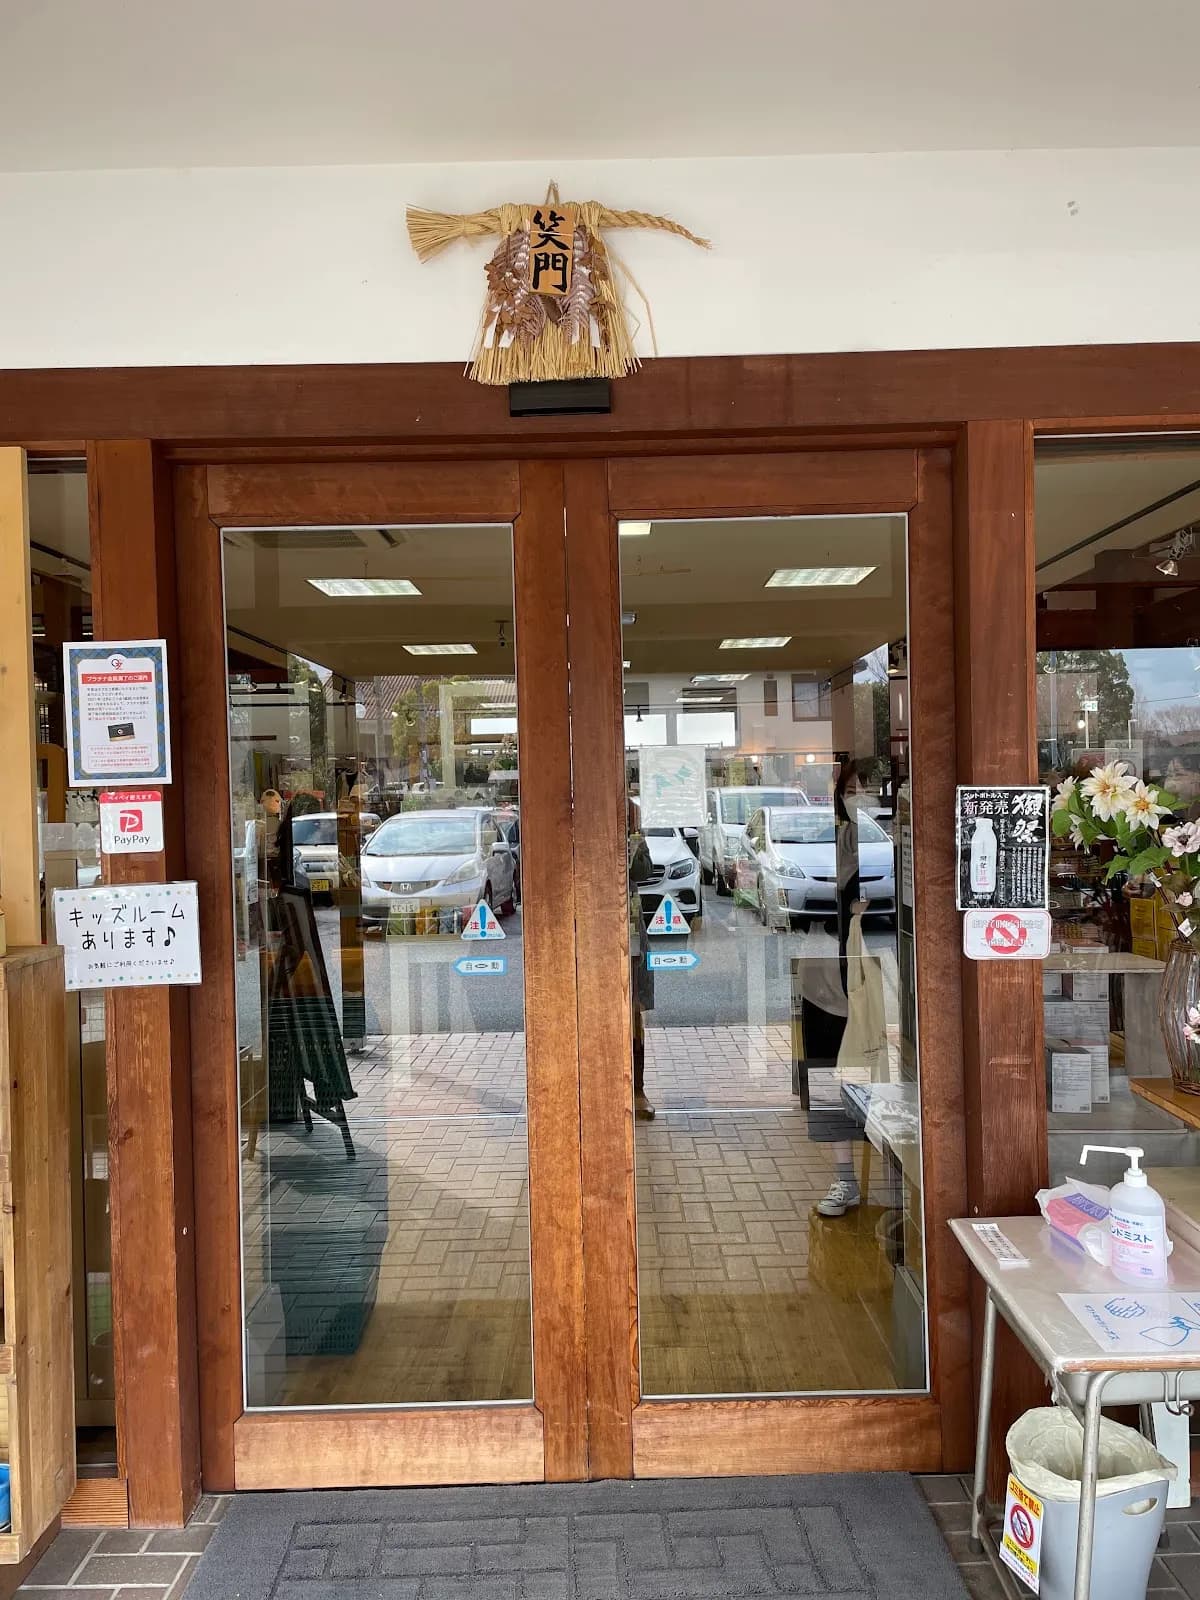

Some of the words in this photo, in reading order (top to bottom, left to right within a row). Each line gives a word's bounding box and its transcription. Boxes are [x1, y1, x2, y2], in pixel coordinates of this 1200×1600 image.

[531, 209, 571, 293] 笑門
[963, 792, 1010, 800] ペットボトル入で
[963, 800, 1009, 815] 新発売
[114, 835, 151, 845] PayPay
[68, 902, 185, 928] キッズルーム
